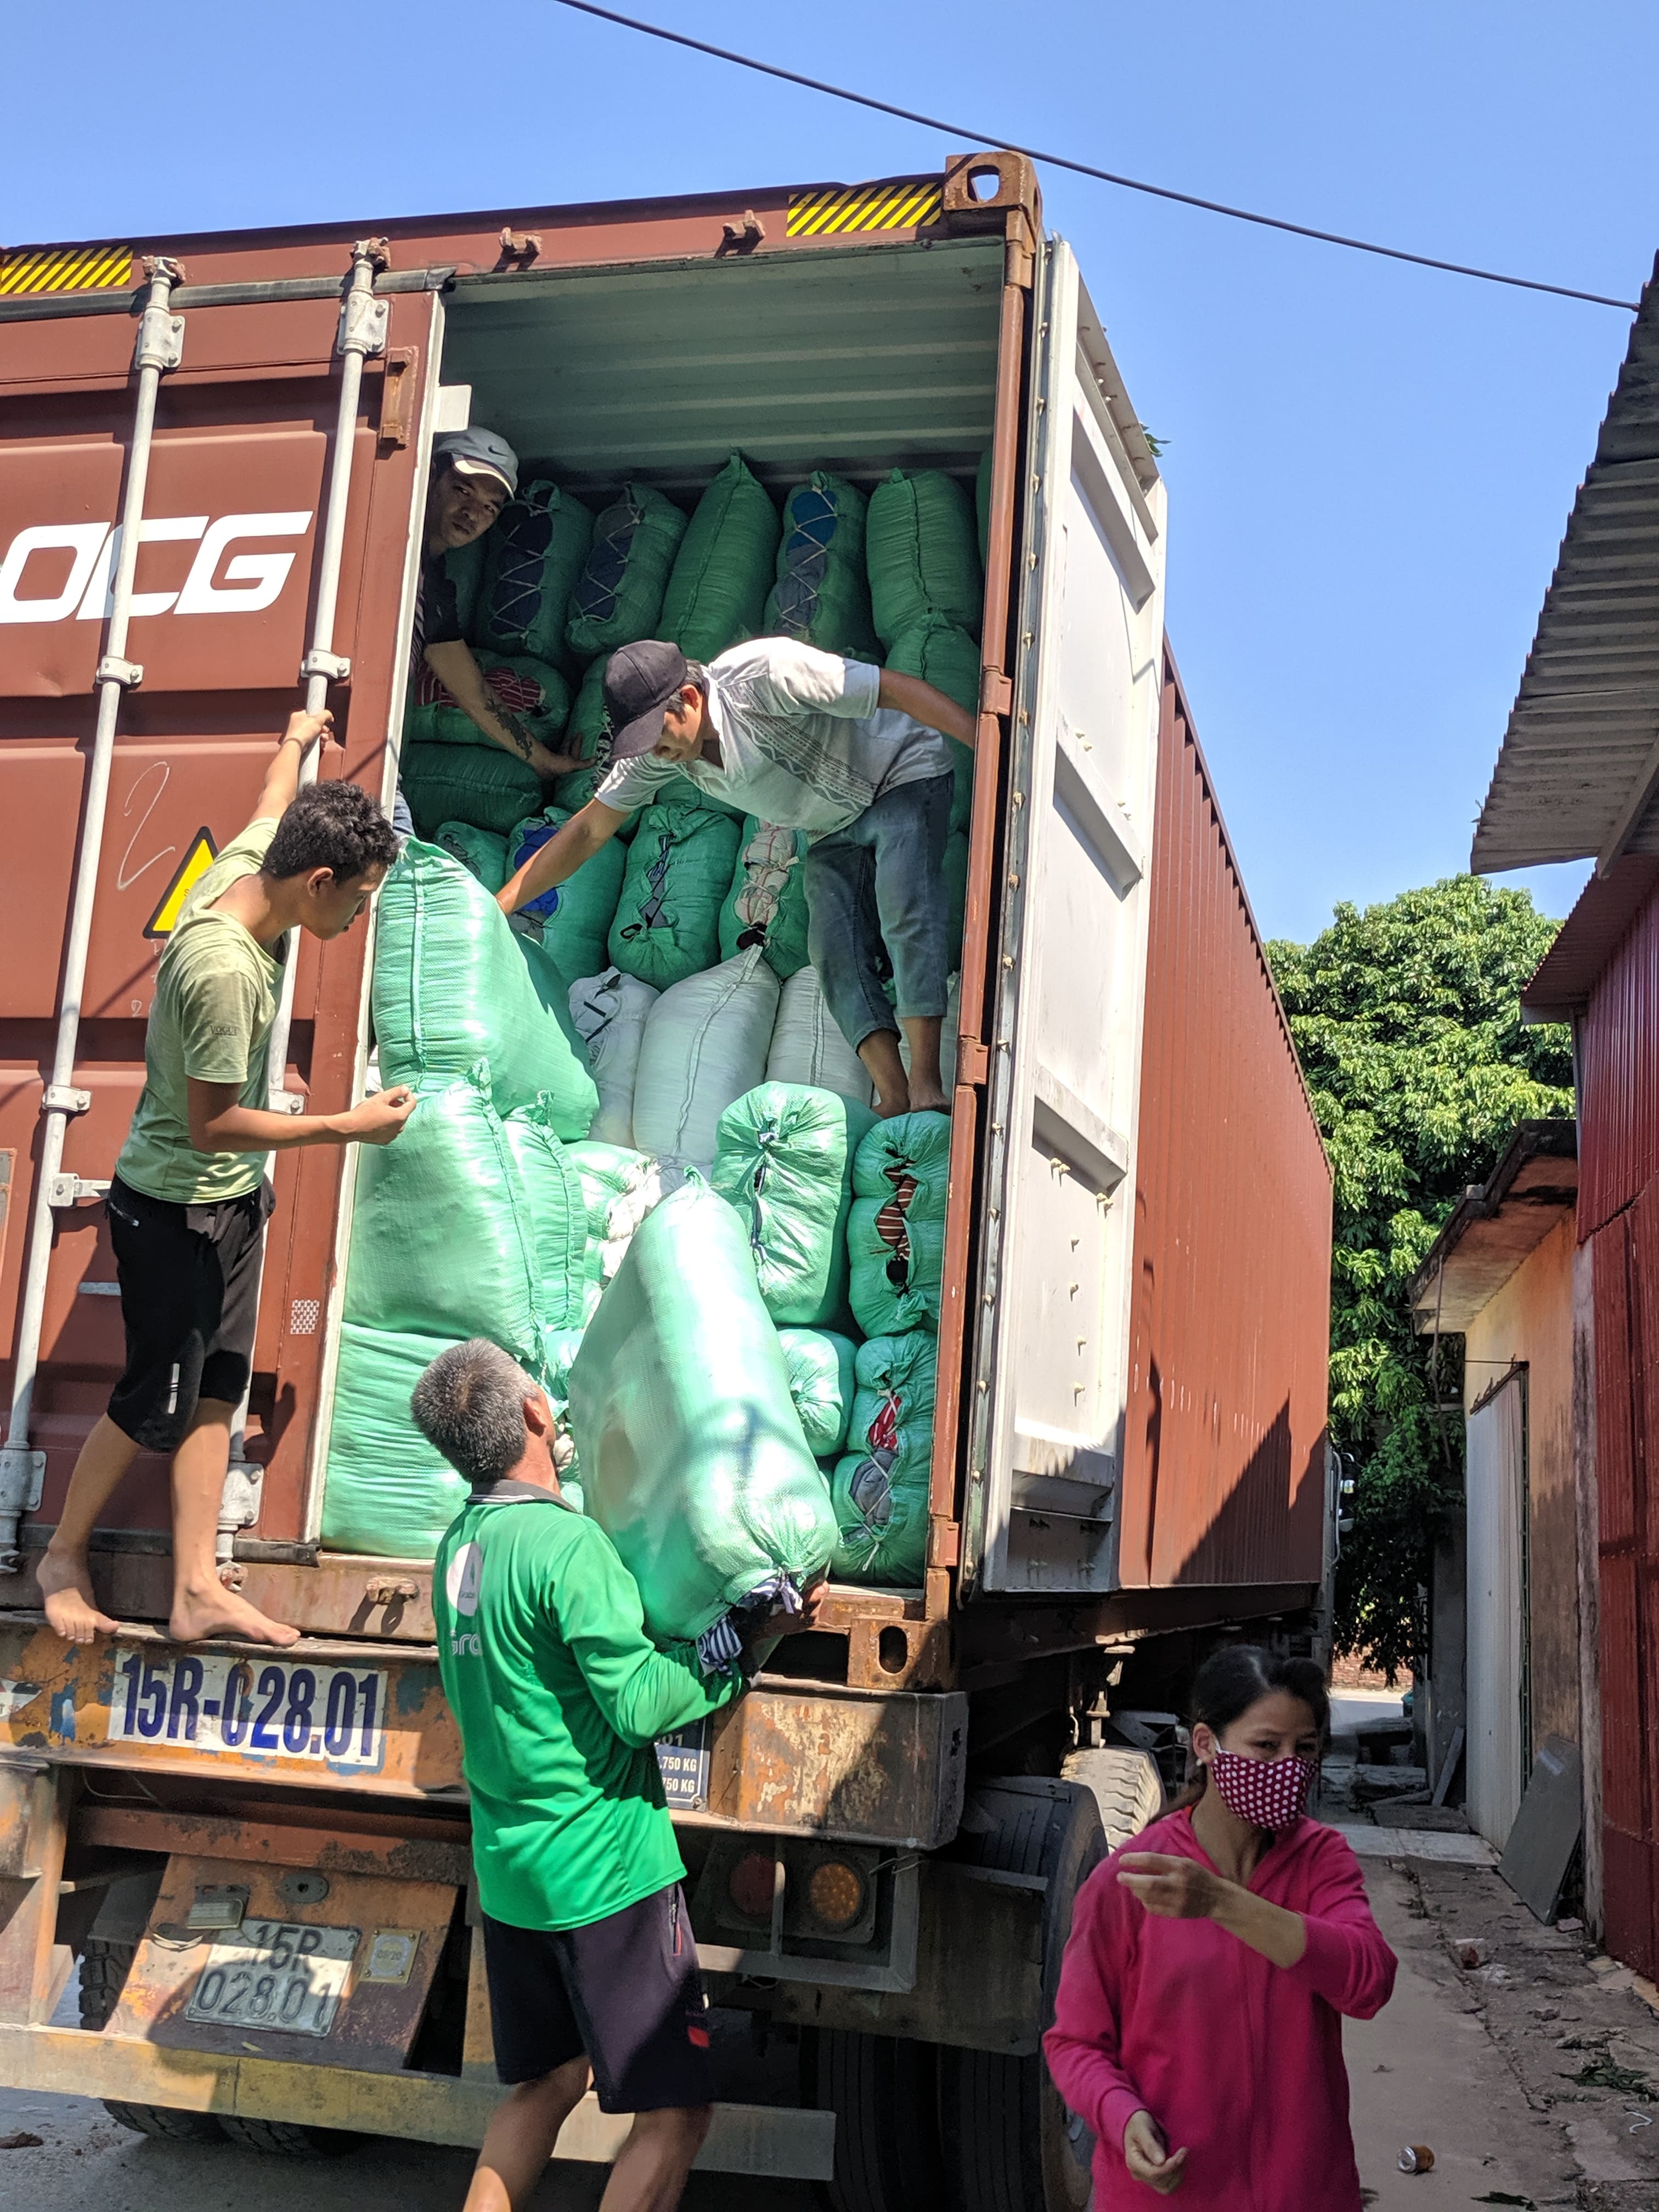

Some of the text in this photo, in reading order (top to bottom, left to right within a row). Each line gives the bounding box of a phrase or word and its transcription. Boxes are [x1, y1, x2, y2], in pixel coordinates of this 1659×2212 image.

[122, 1653, 379, 1757] 15R-028.01
[682, 1757, 697, 1772] KG
[680, 1779, 695, 1793] KG
[250, 1924, 324, 1973] 15R
